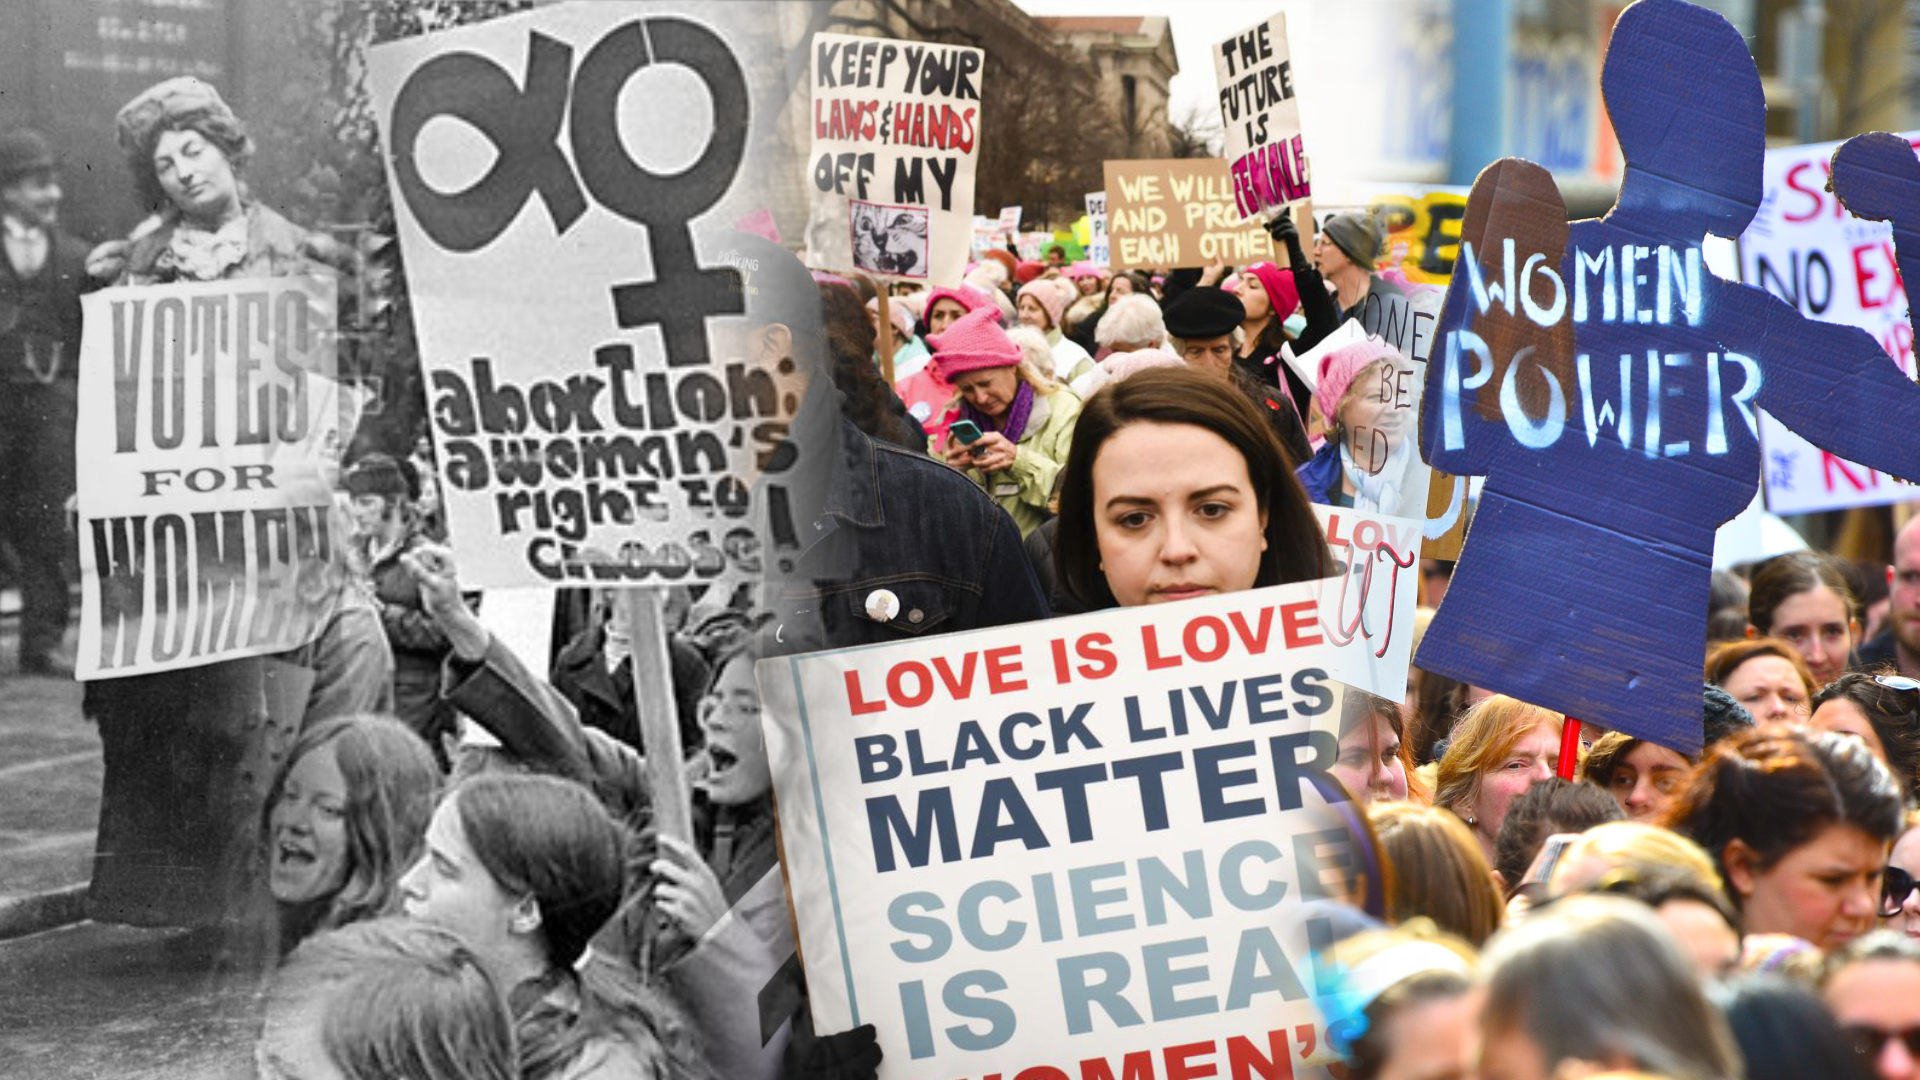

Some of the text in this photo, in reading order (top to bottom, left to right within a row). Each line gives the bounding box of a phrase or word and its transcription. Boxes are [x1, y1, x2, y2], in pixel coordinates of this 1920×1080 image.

[818, 41, 982, 100] KEEP YOUR
[1222, 21, 1273, 77] THE
[816, 99, 879, 141] LAWS
[893, 102, 976, 155] HANDS
[1219, 60, 1295, 128] FUTURE
[1241, 112, 1269, 148] IS
[815, 153, 957, 211] OFF MY
[1118, 170, 1235, 204] WE WILL
[1230, 134, 1311, 220] FEMALE
[1112, 200, 1307, 233] AND PROT
[1120, 233, 1179, 265] EACH
[1463, 238, 1700, 327] WOMEN
[1757, 247, 1833, 315] NO
[111, 290, 310, 454] VOTES
[430, 344, 798, 436] abortion:
[1379, 363, 1414, 410] BE
[1443, 329, 1764, 460] POWER
[141, 464, 277, 497] FOR
[444, 439, 489, 491] a
[499, 475, 750, 541] right to
[90, 505, 330, 671] WOMEN
[843, 599, 1325, 716] LOVE IS LOVE
[854, 667, 1335, 784] BLACK LIVES
[864, 730, 1352, 874] MATTER
[886, 826, 1355, 964] SCIENCE
[897, 969, 1018, 1061] IS
